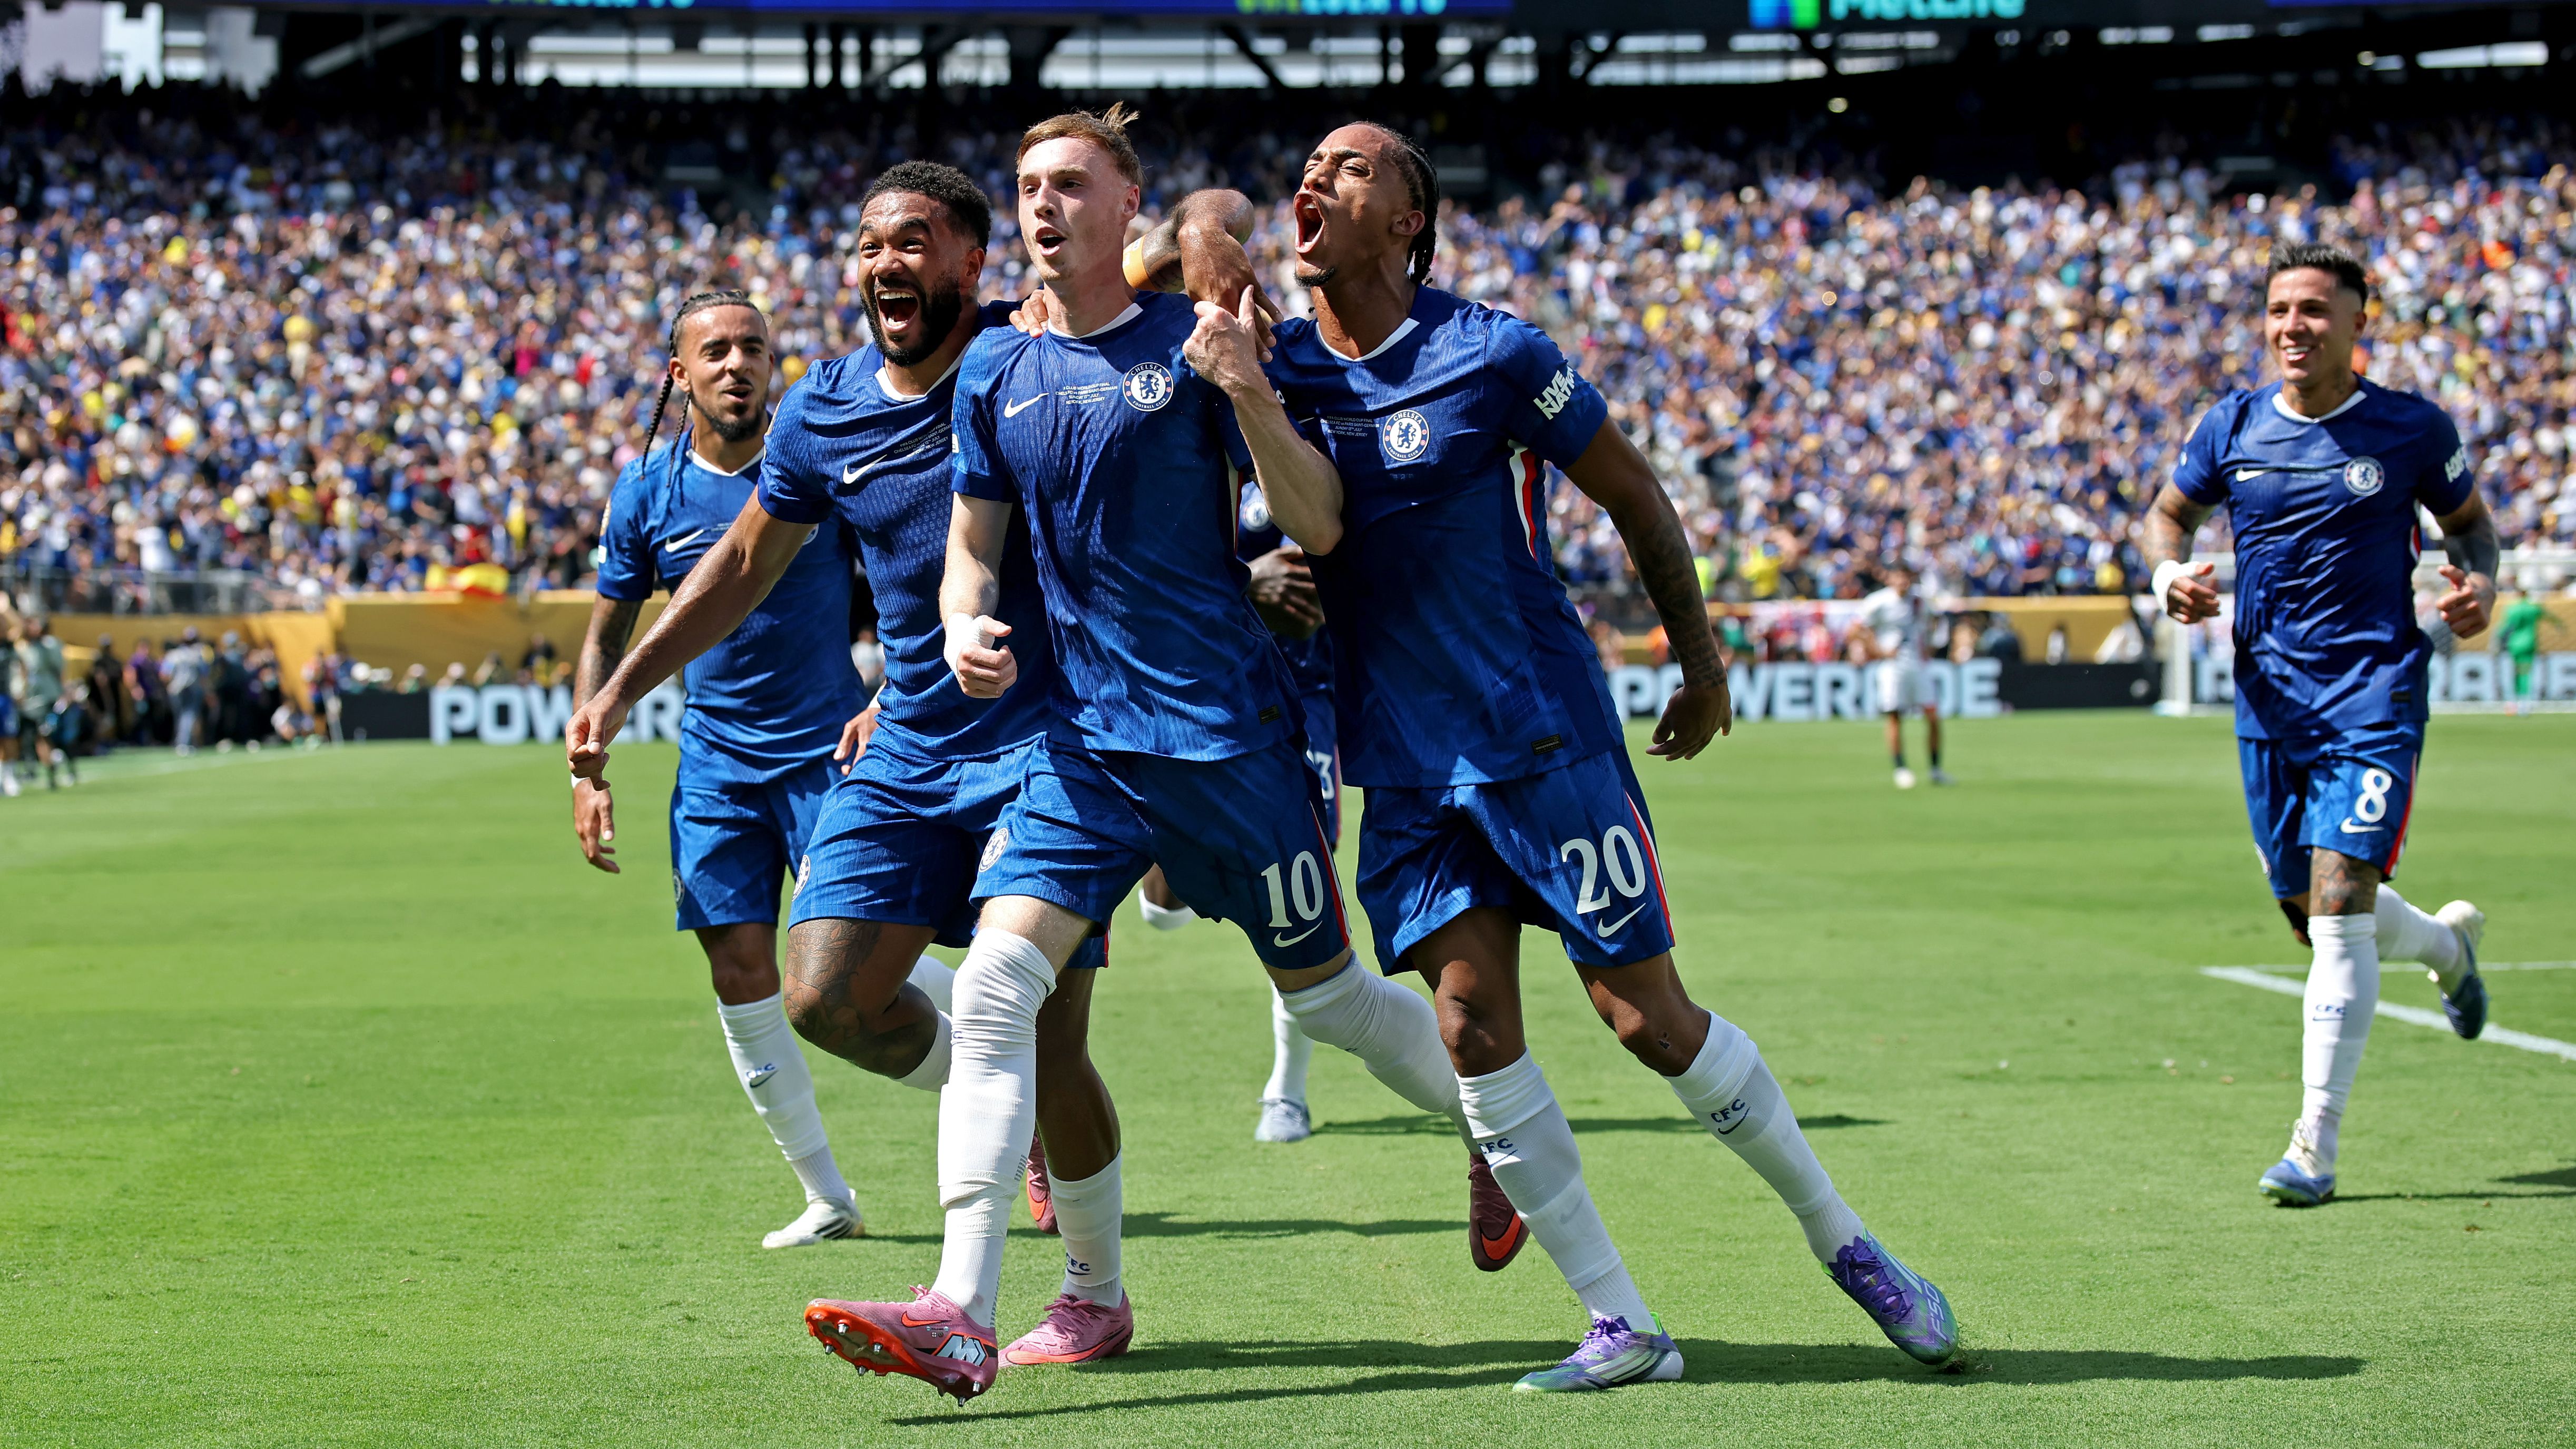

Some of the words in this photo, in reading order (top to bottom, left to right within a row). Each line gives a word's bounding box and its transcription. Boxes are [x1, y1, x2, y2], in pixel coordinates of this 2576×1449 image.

[1130, 364, 1163, 376] CHELSEA
[1133, 400, 1154, 409] FOOTBALL
[1156, 398, 1166, 406] CLUB
[1533, 370, 1566, 410] LIVE
[1393, 412, 1422, 425] CHELSEA
[1388, 447, 1407, 458] FOOTBALL
[2354, 767, 2392, 823] 8
[1560, 825, 1645, 914] 20
[1261, 851, 1323, 927] 10
[1711, 1099, 1745, 1122] CFC
[1924, 1282, 1946, 1340] F50
